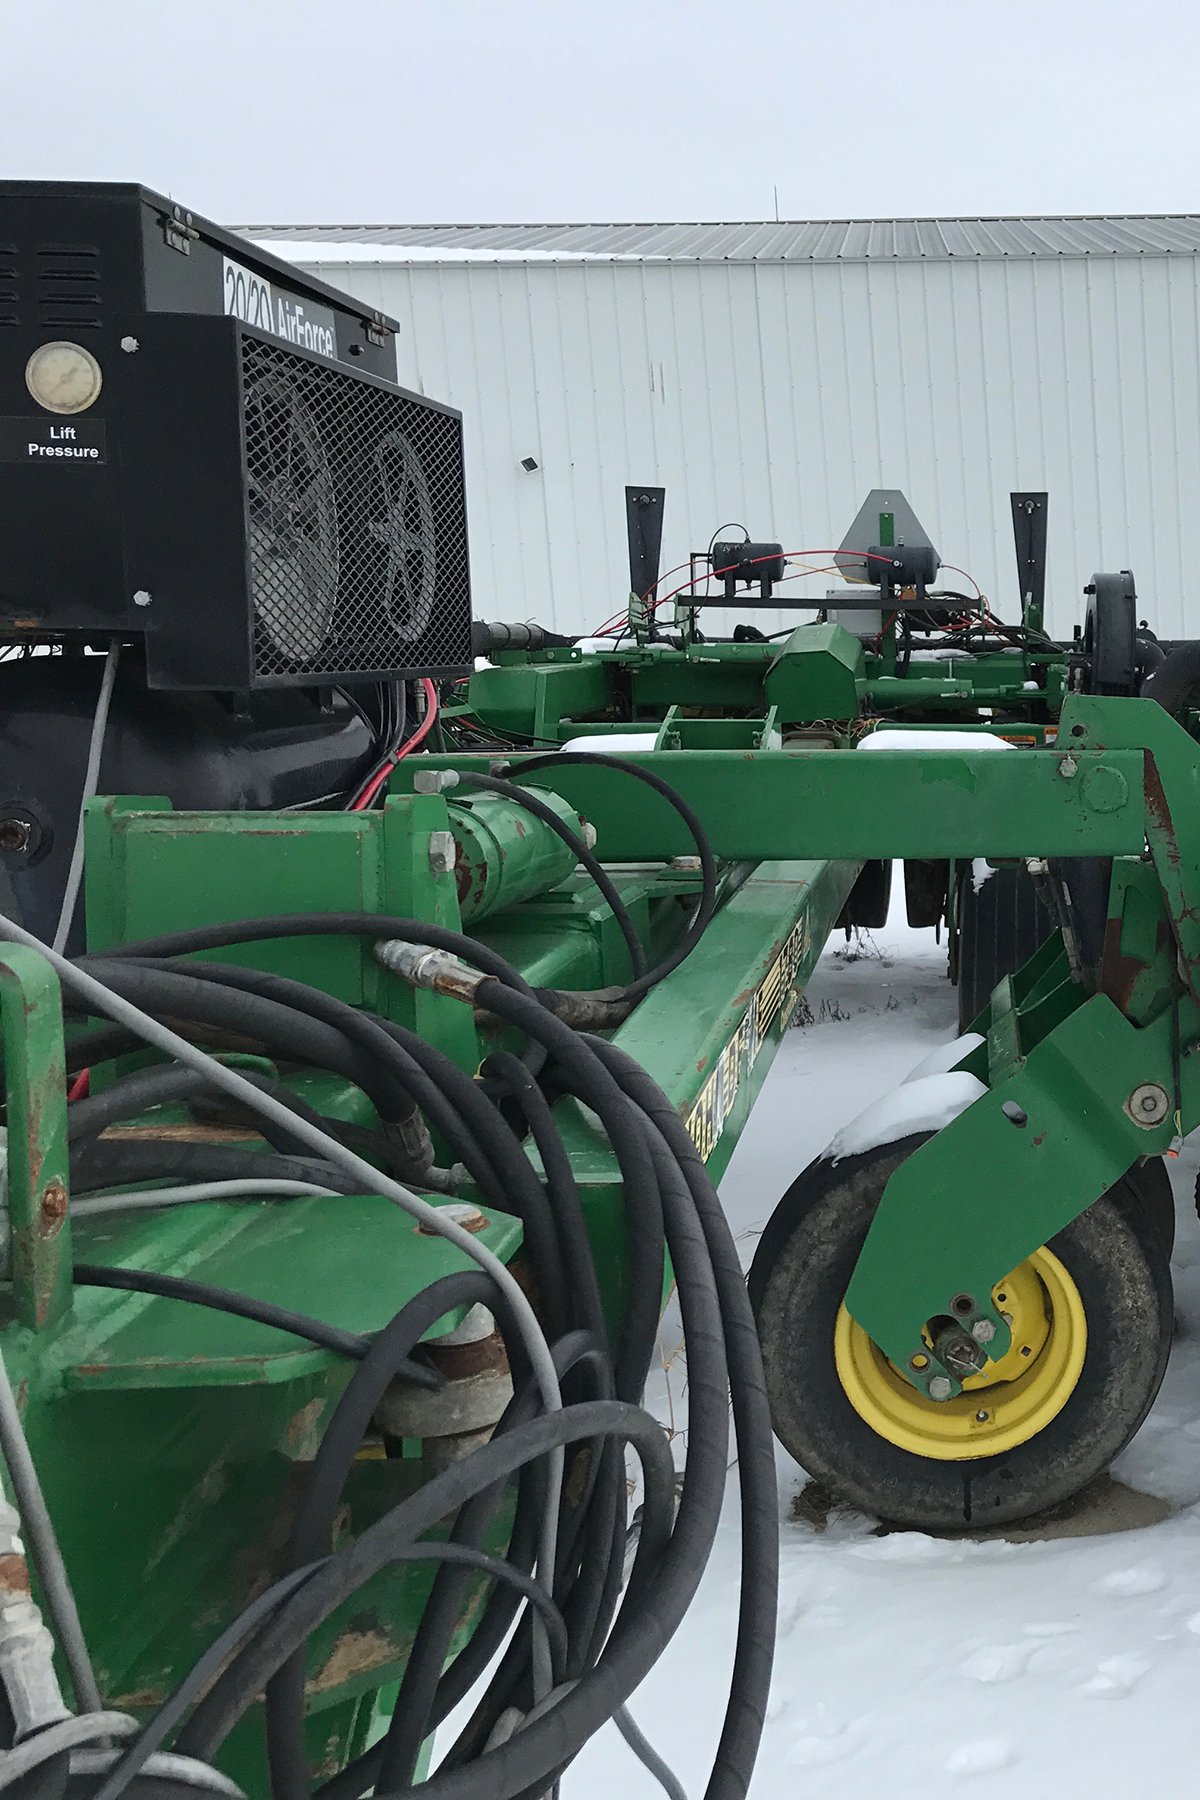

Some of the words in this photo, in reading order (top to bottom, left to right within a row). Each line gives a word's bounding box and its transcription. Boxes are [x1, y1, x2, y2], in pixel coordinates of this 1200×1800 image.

[225, 265, 273, 333] 20/20
[278, 297, 334, 359] AirForce
[50, 426, 77, 440] Lift
[28, 443, 99, 458] Pressure
